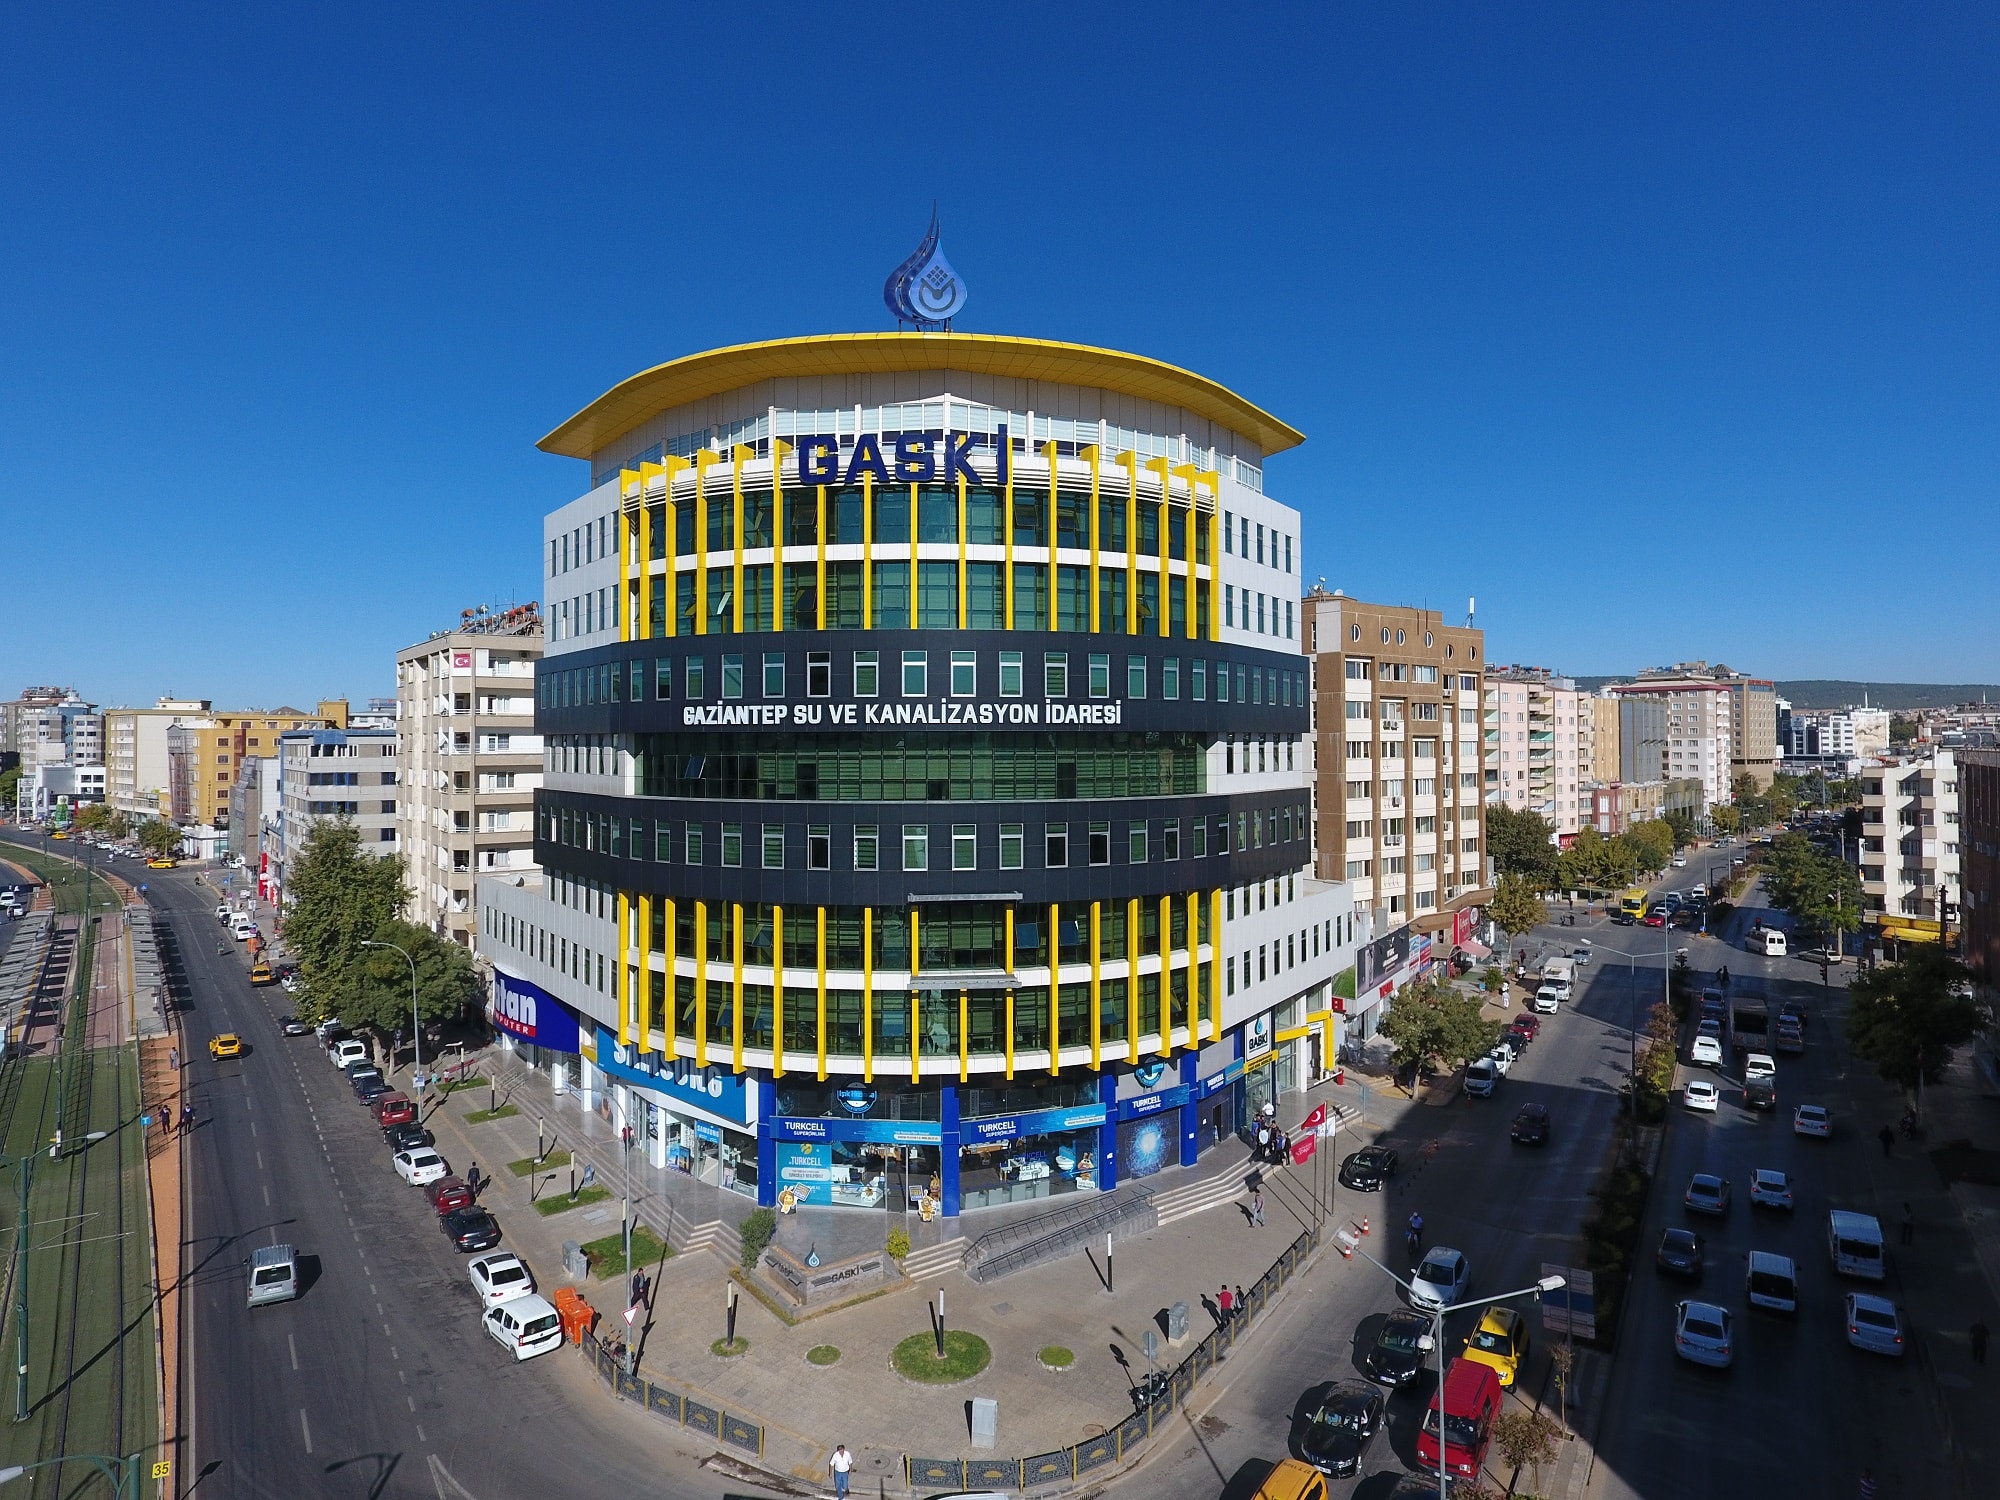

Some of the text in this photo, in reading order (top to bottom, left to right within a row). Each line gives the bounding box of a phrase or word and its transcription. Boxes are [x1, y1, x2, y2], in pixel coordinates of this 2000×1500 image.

[683, 698, 1121, 725] GAZİANTEP SU VE KANALİZASYON İDARESİ
[1132, 1095, 1161, 1109] TURKCELL
[785, 1121, 826, 1131] TURKCELL
[977, 1120, 1017, 1133] TURKCELL
[790, 1156, 822, 1167] TURKCELL
[154, 1463, 169, 1476] 35
